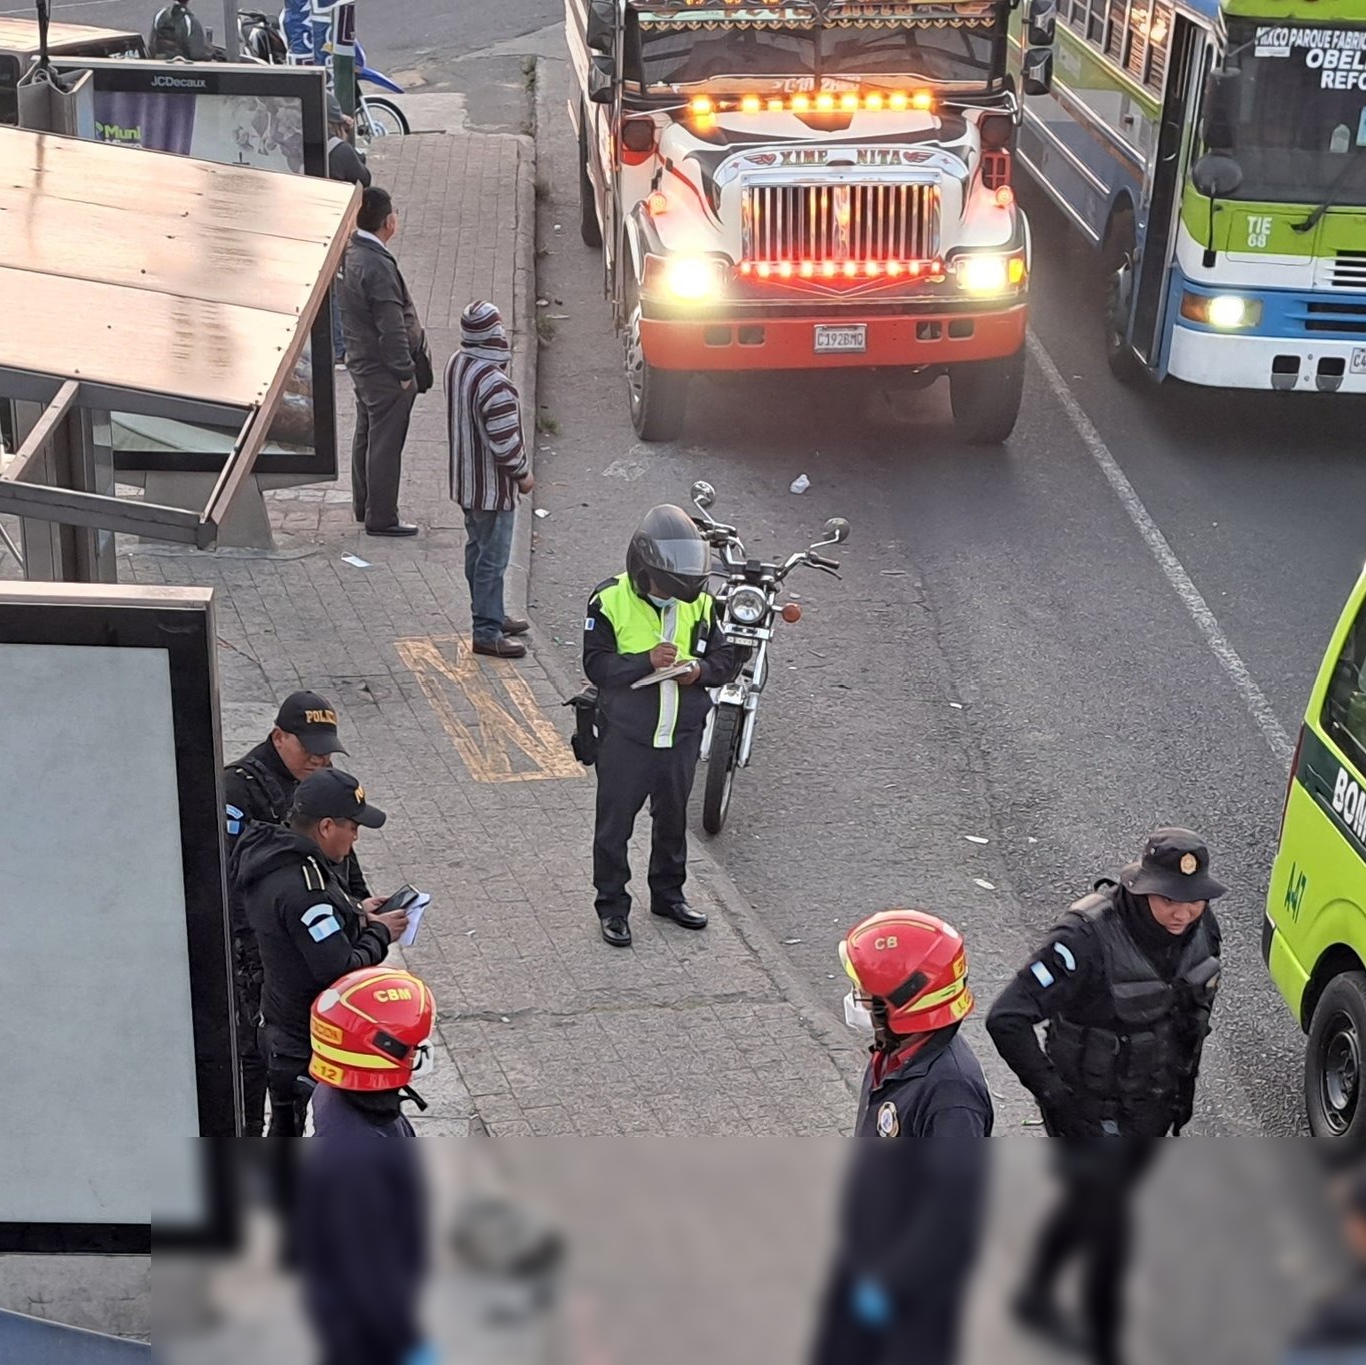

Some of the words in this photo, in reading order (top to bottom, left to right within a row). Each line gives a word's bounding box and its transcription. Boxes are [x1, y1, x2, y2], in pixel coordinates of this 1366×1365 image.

[1289, 28, 1333, 49] PARQUE
[150, 75, 207, 89] JCDecaux
[373, 987, 412, 1002] CBM
